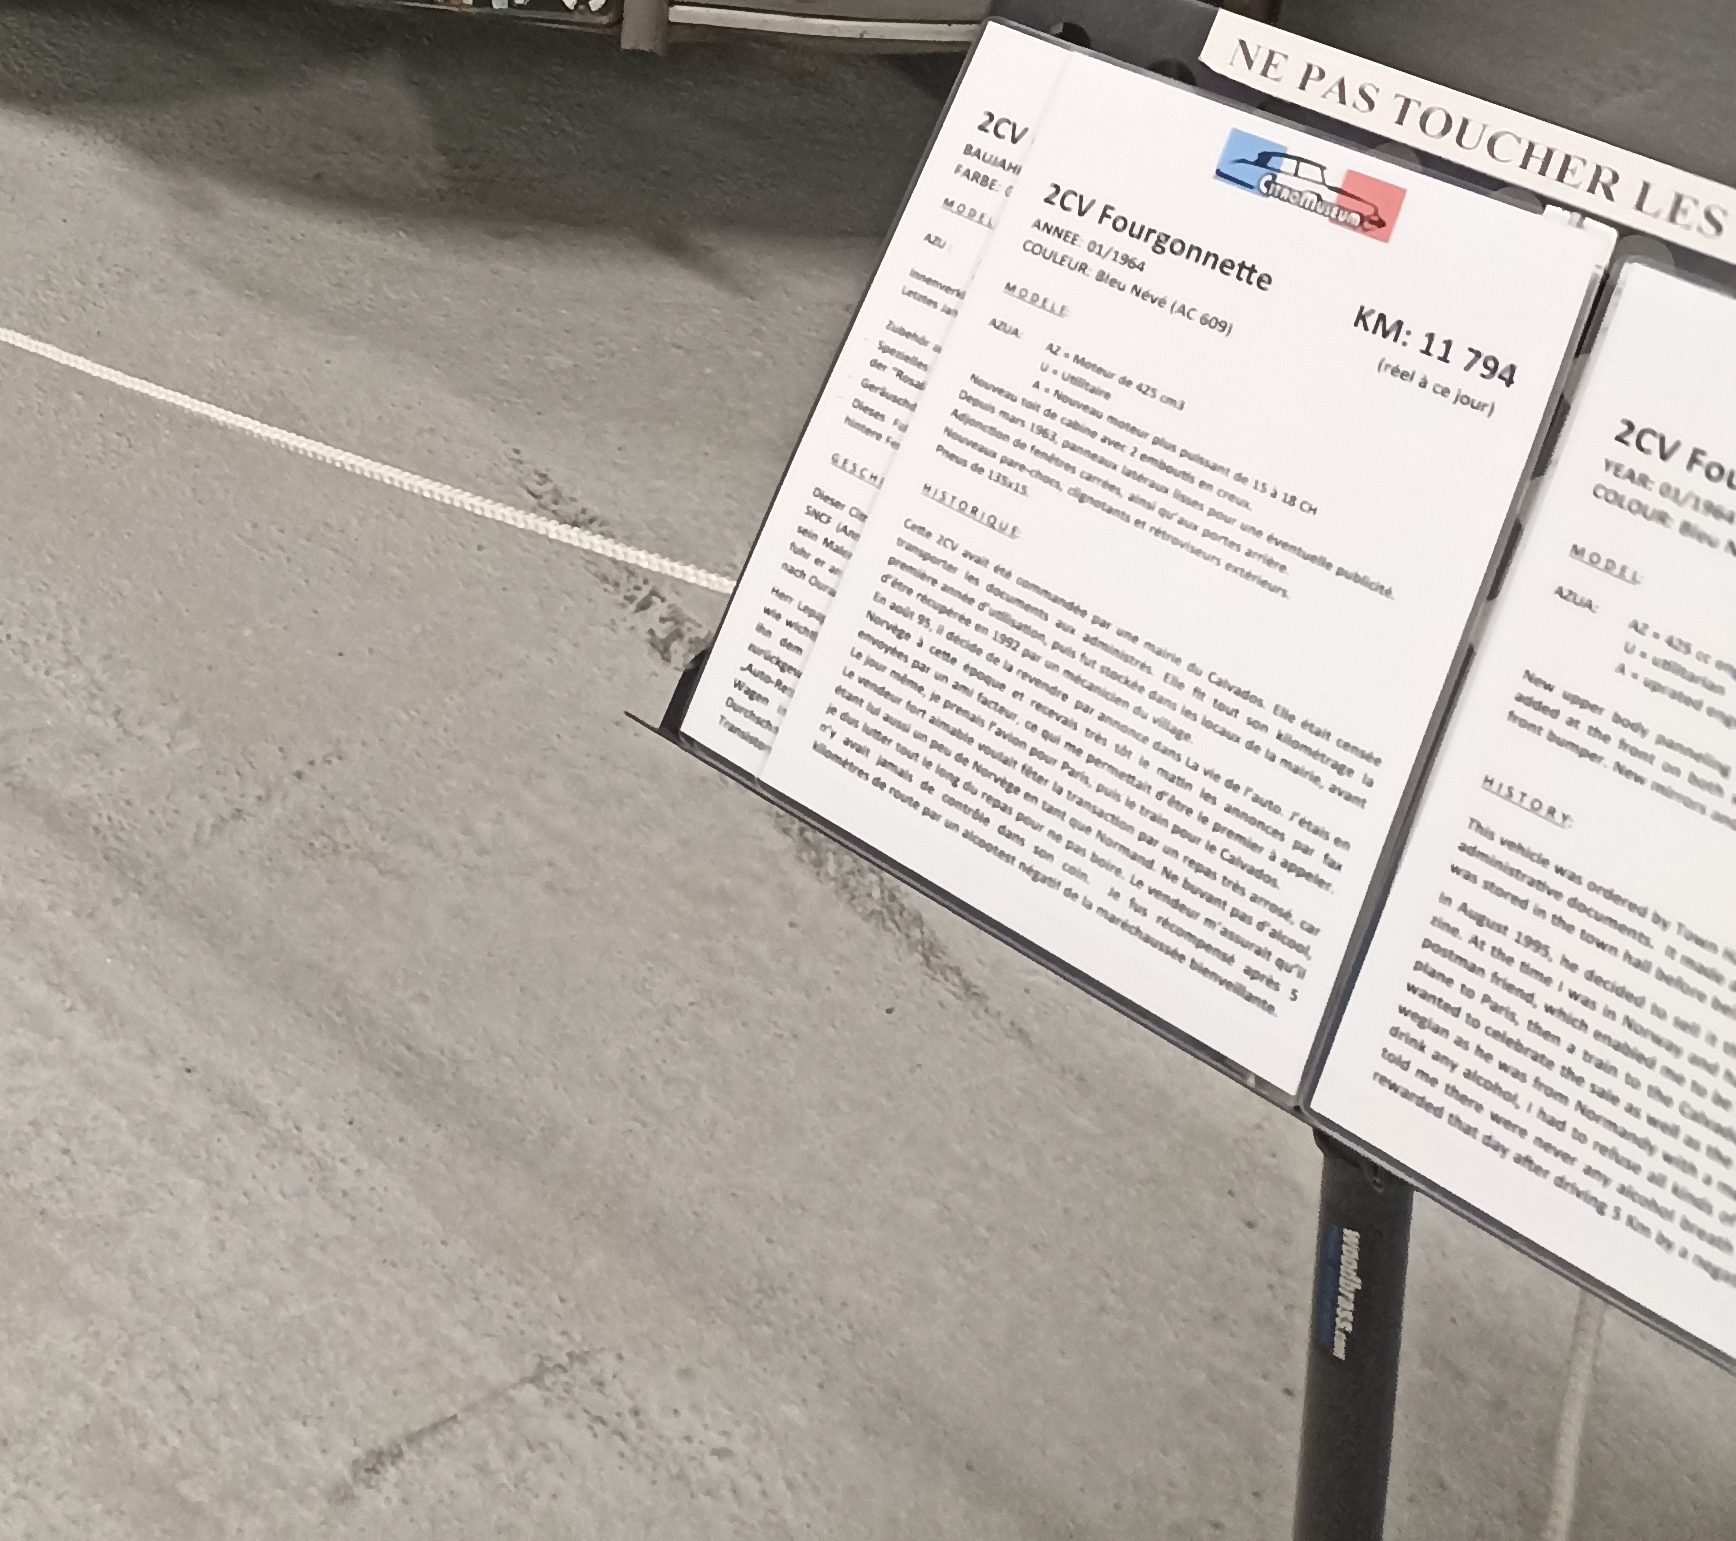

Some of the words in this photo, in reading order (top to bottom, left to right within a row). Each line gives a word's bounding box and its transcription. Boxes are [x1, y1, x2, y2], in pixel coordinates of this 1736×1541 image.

[977, 110, 1029, 144] 2CV
[1228, 37, 1289, 83] NE
[1298, 61, 1381, 114] PAS
[1392, 93, 1621, 204] TOUCHER
[1633, 179, 1731, 241] LES
[1043, 182, 1096, 217] 2CV
[1097, 203, 1272, 291] Fourgonnette
[1086, 239, 1145, 272] 01/1964
[1094, 268, 1126, 291] Bleu
[1129, 283, 1167, 308] Névé
[1169, 299, 1197, 320] (AC
[1199, 312, 1233, 337] 609)
[1376, 356, 1416, 383] (réel
[1417, 373, 1428, 389] à
[1431, 382, 1450, 398] ce
[1451, 387, 1495, 418] jour)
[1418, 332, 1453, 363] 11
[1463, 346, 1517, 388] 794
[1613, 417, 1682, 463] 2CV
